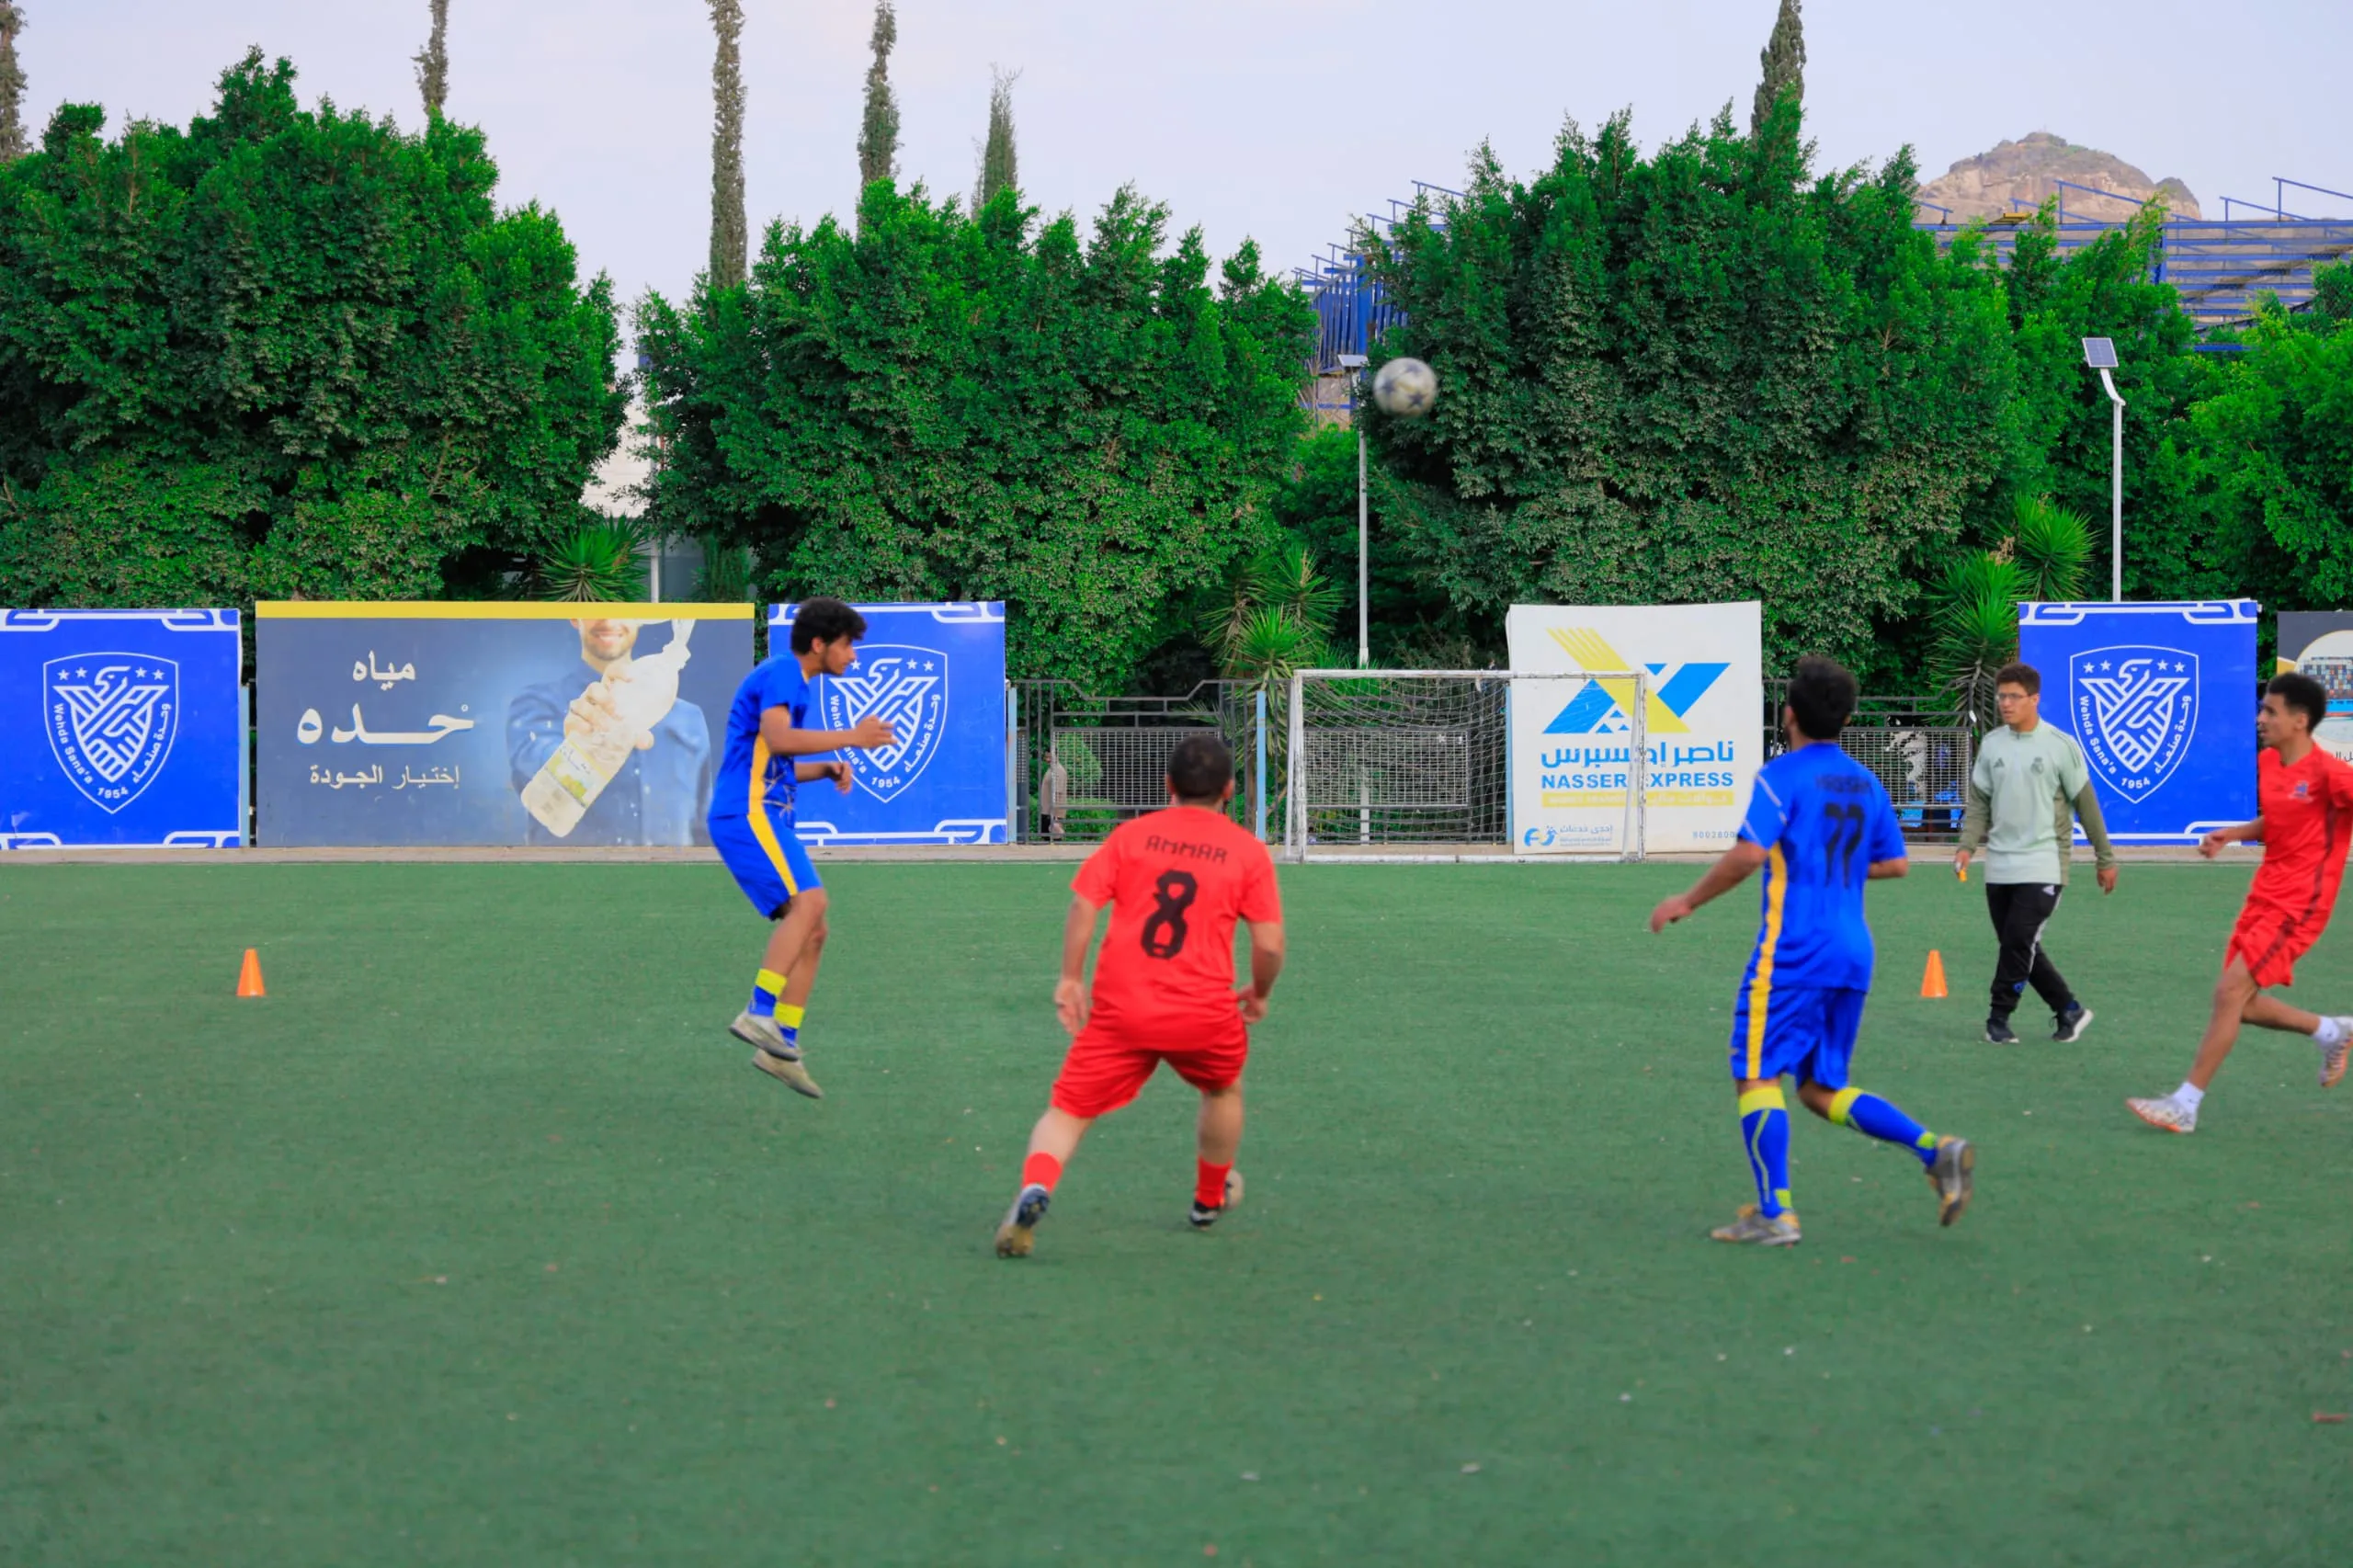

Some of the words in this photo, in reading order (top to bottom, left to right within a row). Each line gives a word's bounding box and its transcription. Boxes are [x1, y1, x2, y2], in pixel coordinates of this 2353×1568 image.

[352, 650, 416, 691] مياه
[53, 703, 69, 744] Wehda
[2080, 696, 2094, 736] Wehda
[844, 745, 868, 774] ana'a
[1672, 741, 1734, 767] ناصر
[310, 764, 383, 790] الجودة
[871, 776, 901, 788] 1954
[1541, 773, 1629, 789] NASSER
[1645, 772, 1733, 788] XPRESS
[2120, 777, 2151, 789] 1954
[97, 787, 129, 799] 1954
[1145, 835, 1228, 865] AMMAR
[1141, 869, 1198, 960] 8
